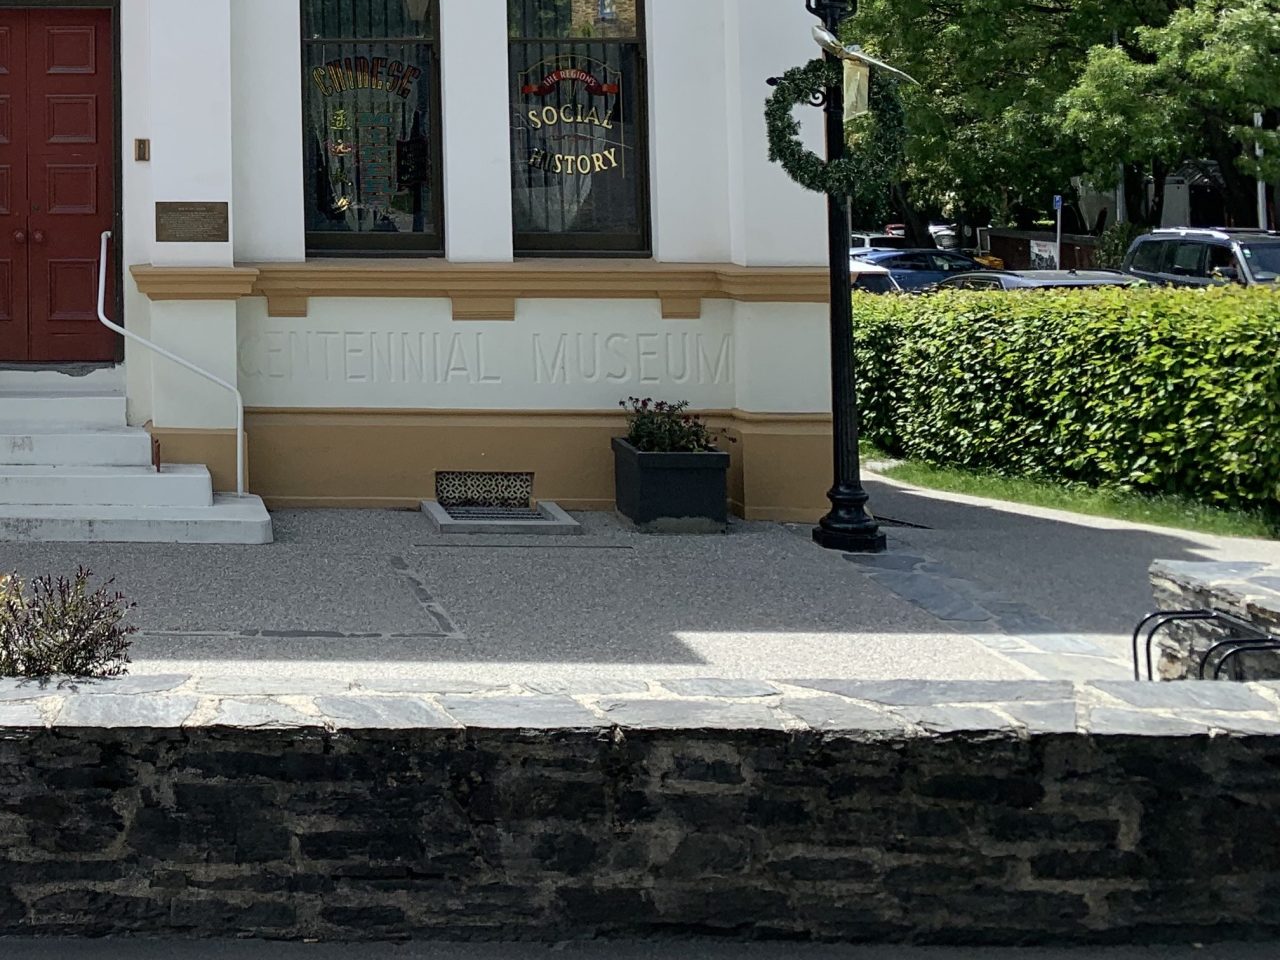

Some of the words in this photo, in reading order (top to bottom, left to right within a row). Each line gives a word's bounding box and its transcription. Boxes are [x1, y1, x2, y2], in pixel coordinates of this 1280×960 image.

[312, 55, 422, 100] CHINESE
[543, 72, 559, 87] THE
[528, 103, 613, 130] SOCIAL
[528, 147, 618, 174] HISTORY
[531, 332, 735, 385] MUSEUM
